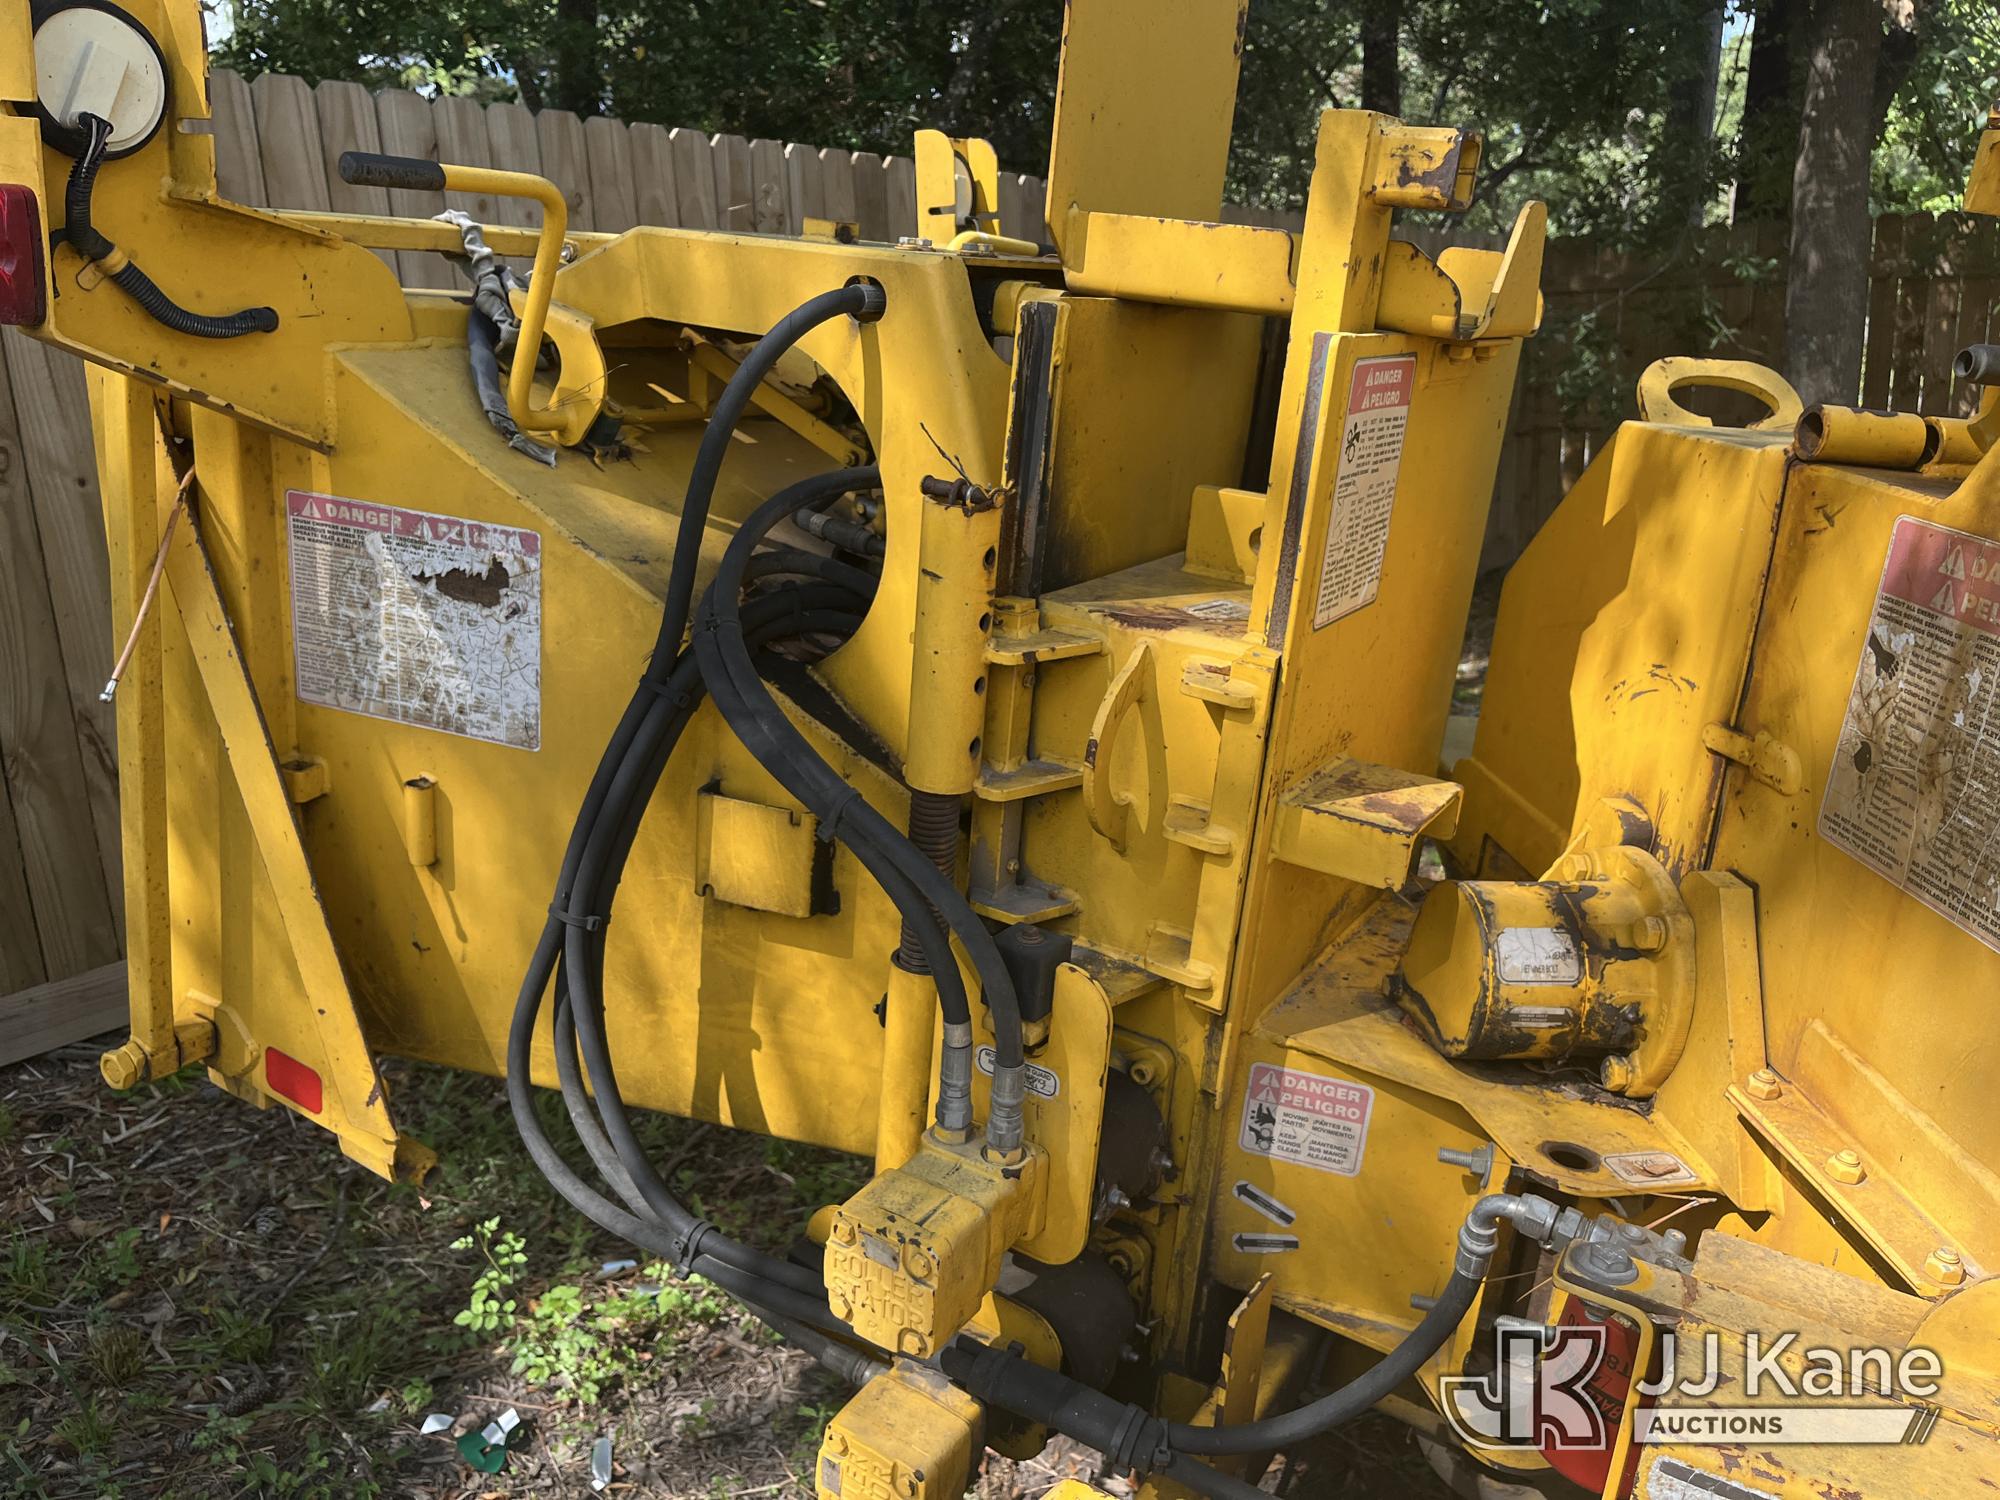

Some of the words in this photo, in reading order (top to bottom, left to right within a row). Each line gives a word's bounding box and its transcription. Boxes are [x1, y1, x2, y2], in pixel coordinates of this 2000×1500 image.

[1374, 369, 1402, 385] DANGER
[1370, 390, 1400, 408] PELIGRO
[325, 503, 402, 529] DANGER
[1920, 865, 1942, 882] VUELVA
[1283, 1075, 1361, 1103] DANGER
[1279, 1091, 1360, 1120] PELIGRO
[1280, 1118, 1305, 1128] PARTS!
[1282, 1112, 1309, 1122] MOVING
[1278, 1132, 1297, 1140] KEEP
[1311, 1125, 1355, 1140] MOVIMIENTO!
[1276, 1145, 1301, 1154] CLEAR!
[1277, 1138, 1301, 1148] HANDS
[1306, 1152, 1344, 1165] ALEJADAS!
[1322, 1149, 1347, 1159] MANOS
[832, 1275, 924, 1330] STATOR
